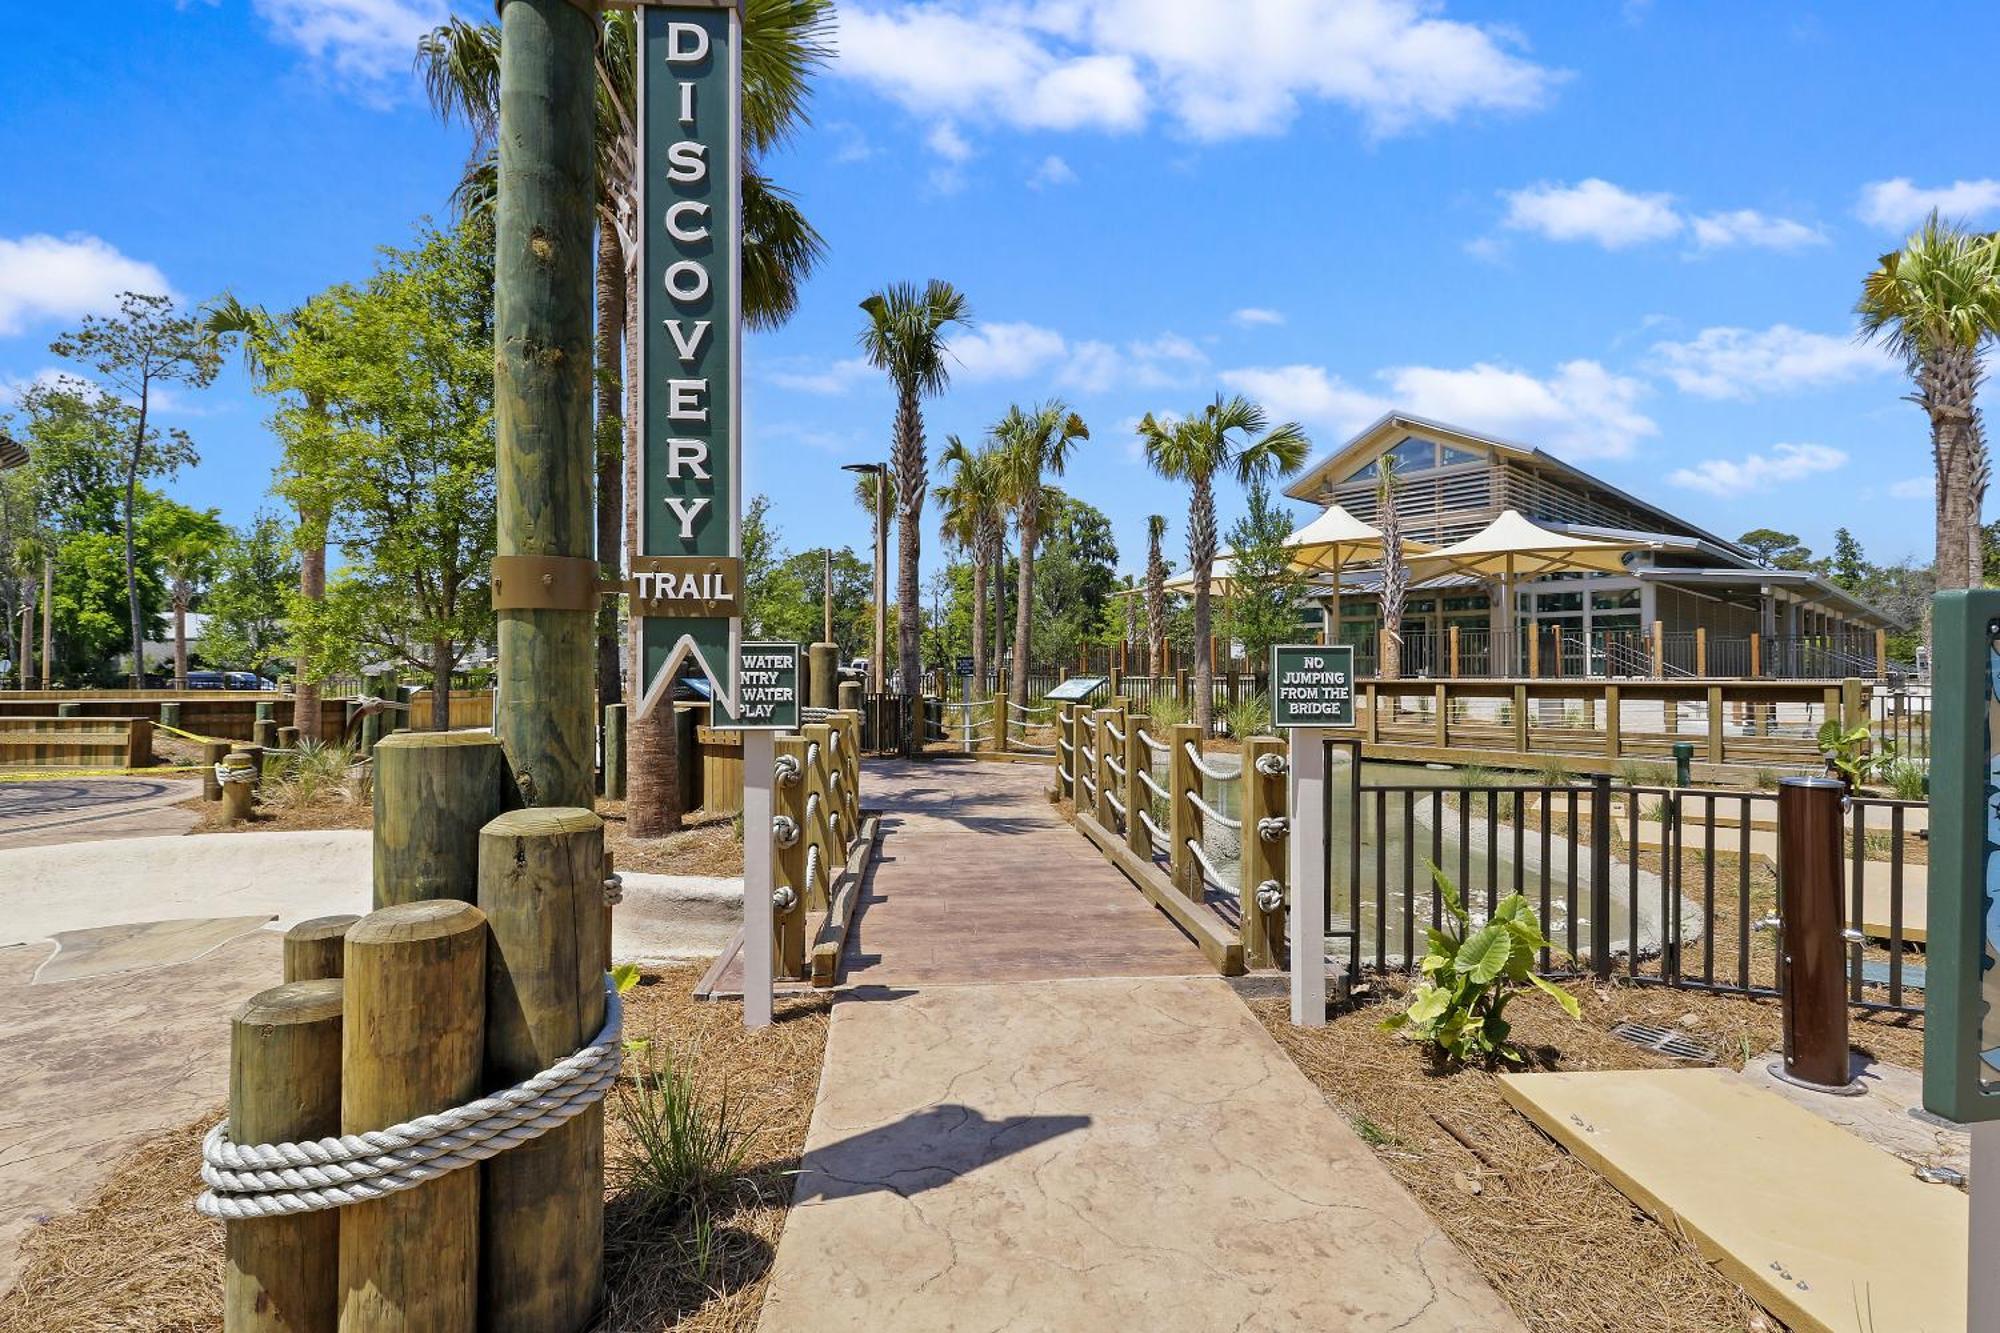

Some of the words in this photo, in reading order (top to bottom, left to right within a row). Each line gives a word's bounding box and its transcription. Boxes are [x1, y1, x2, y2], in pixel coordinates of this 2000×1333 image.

[663, 22, 711, 538] DISCOVERY
[632, 572, 734, 600] TRAIL
[741, 655, 794, 669] WATER
[1303, 656, 1325, 669] NO
[740, 671, 779, 685] NTRY
[1282, 671, 1345, 685] JUMPING
[742, 687, 794, 701] WATER
[1280, 687, 1318, 699] FROM
[1321, 686, 1349, 699] THE
[1288, 702, 1341, 715] BRIDGE
